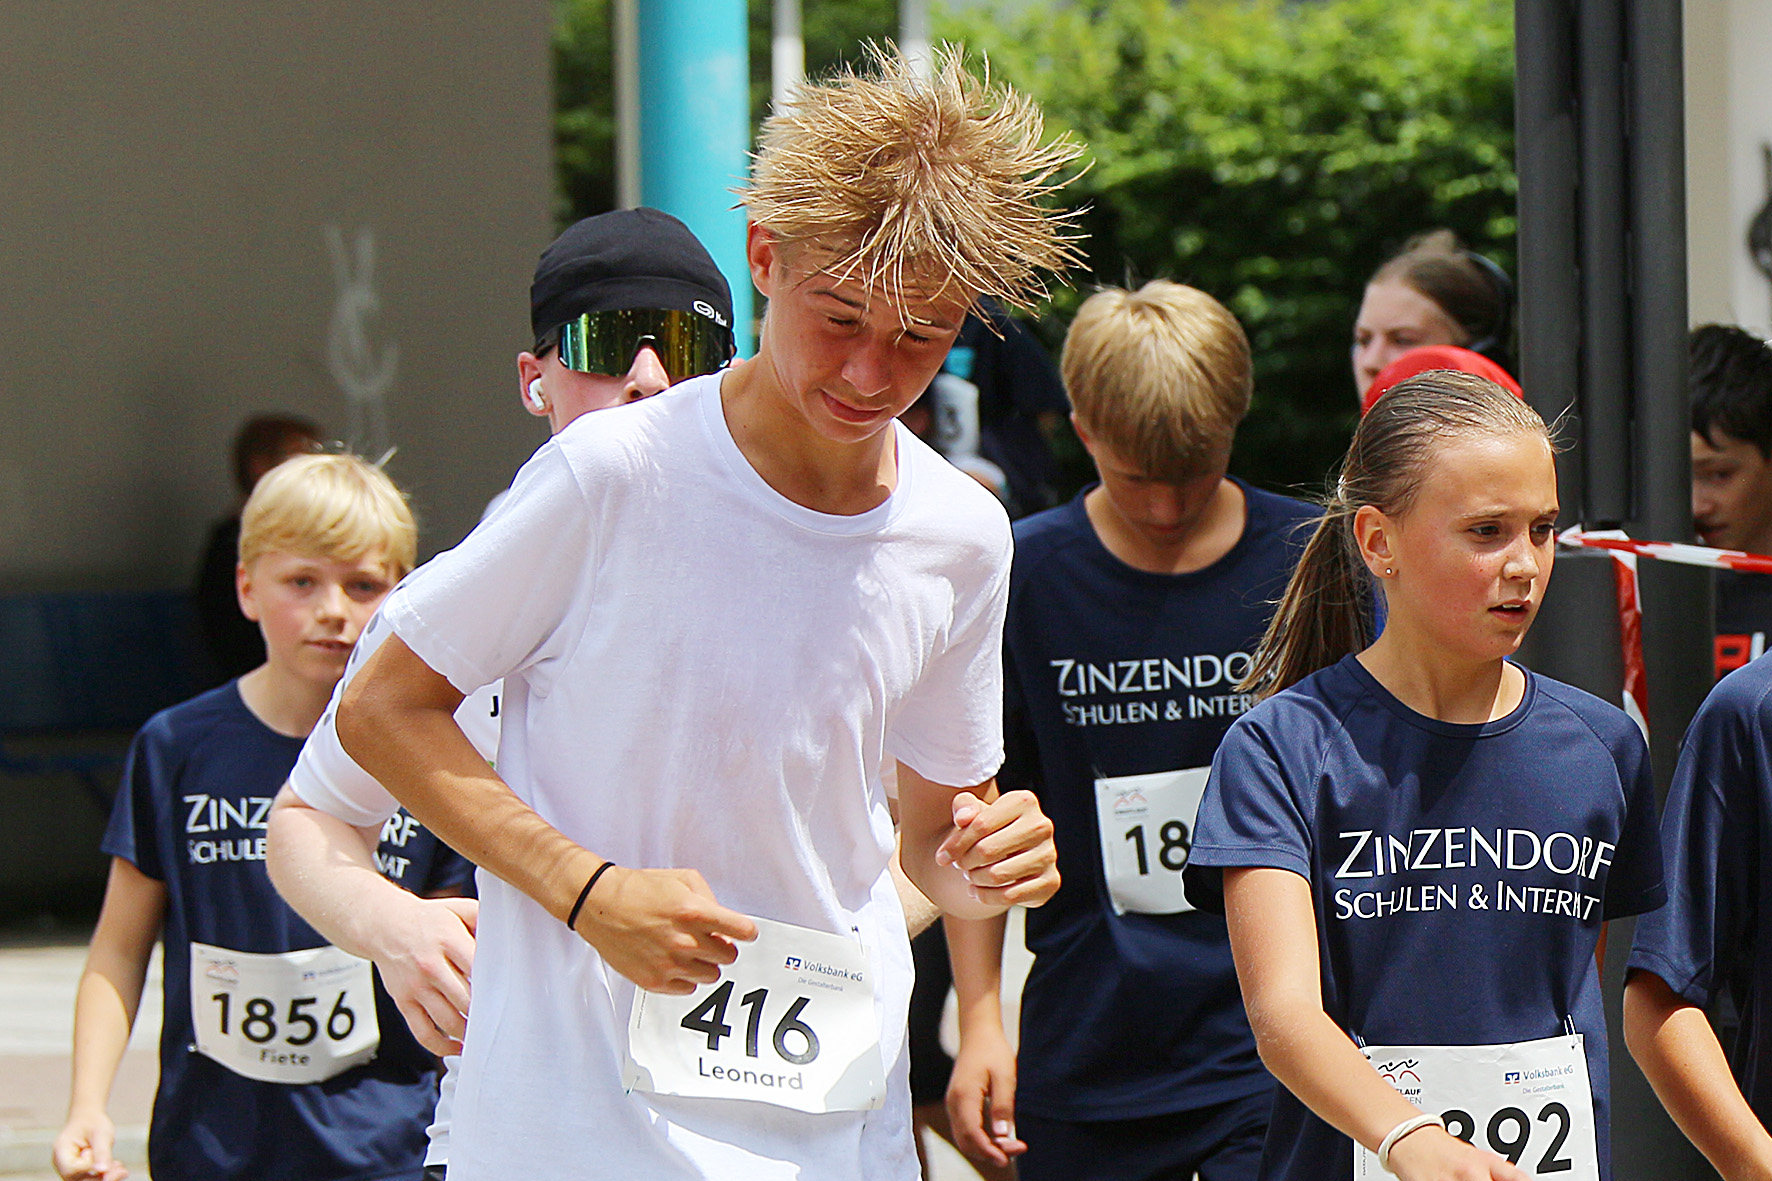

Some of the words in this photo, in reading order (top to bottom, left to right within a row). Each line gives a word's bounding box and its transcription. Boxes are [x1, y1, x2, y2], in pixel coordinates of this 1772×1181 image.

[1050, 650, 1254, 696] ZINZENDO
[1164, 699, 1182, 721] &
[1125, 820, 1192, 876] 18
[1335, 826, 1616, 880] ZINZENDORF
[1468, 883, 1489, 911] &
[804, 960, 849, 979] Volksbank
[212, 991, 356, 1046] 1856
[680, 980, 821, 1066] 416
[259, 1048, 311, 1067] Fiete
[698, 1056, 804, 1090] Leonard
[1523, 1066, 1562, 1080] Volksbank
